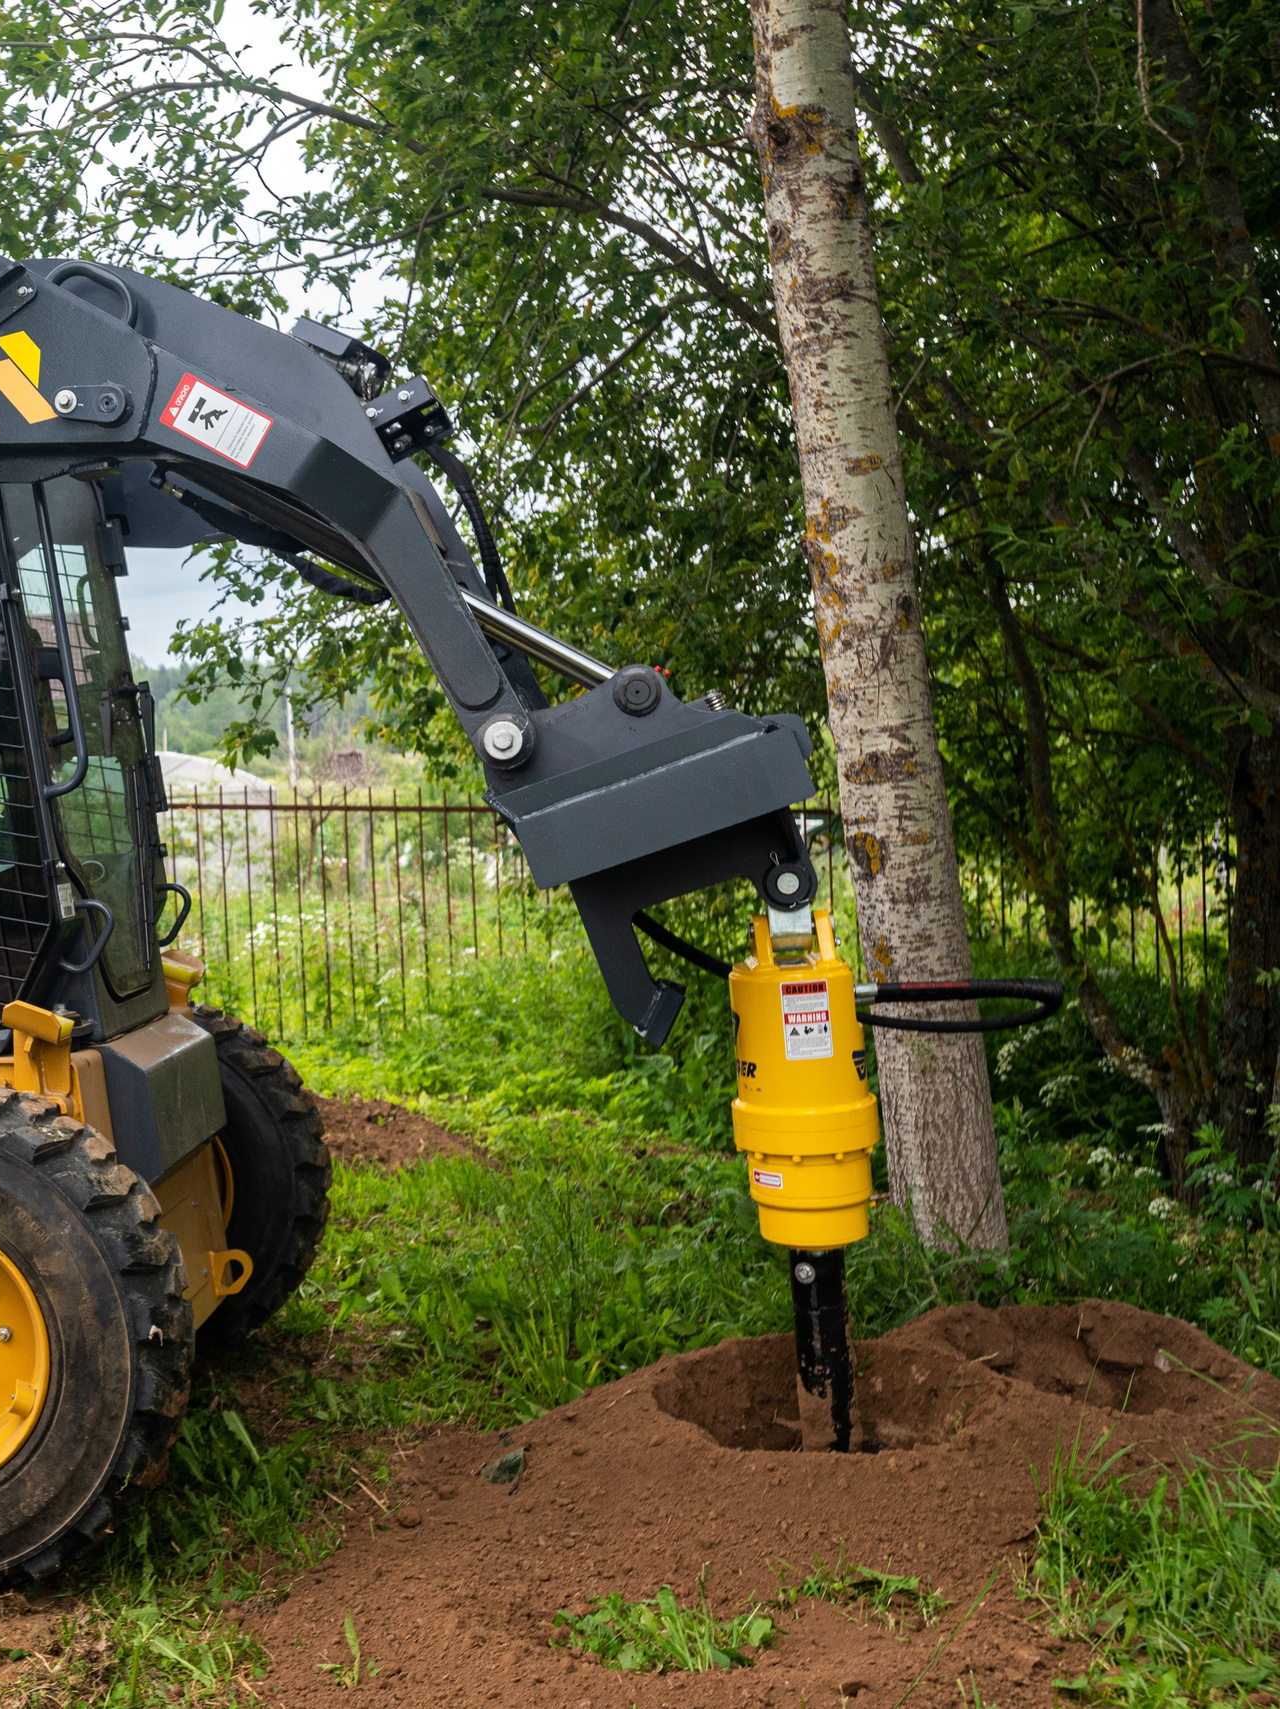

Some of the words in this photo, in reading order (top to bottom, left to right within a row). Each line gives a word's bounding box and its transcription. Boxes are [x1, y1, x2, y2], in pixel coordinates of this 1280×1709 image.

[175, 384, 190, 406] ОПАСНО
[785, 983, 824, 995] CAUTION
[787, 1011, 827, 1024] WARNING
